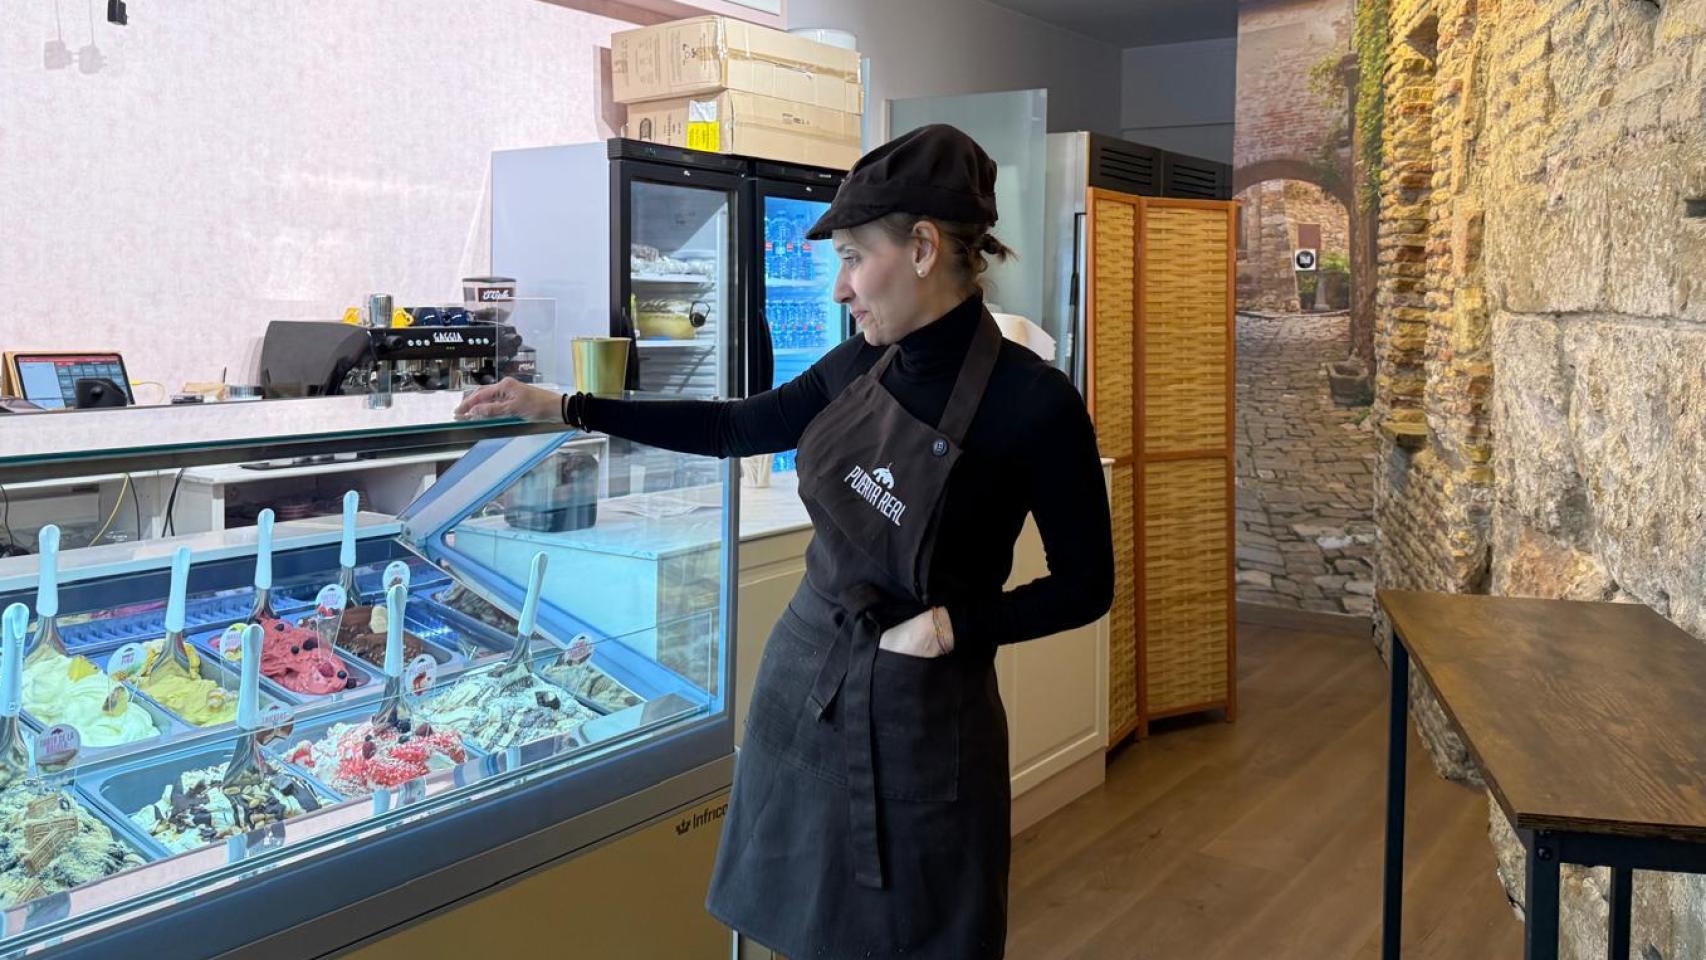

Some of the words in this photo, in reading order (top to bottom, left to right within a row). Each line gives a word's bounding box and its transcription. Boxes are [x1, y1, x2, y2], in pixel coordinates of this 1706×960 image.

[433, 331, 464, 344] GAGGIA
[844, 465, 882, 506] PUERTA
[876, 491, 906, 526] REAL
